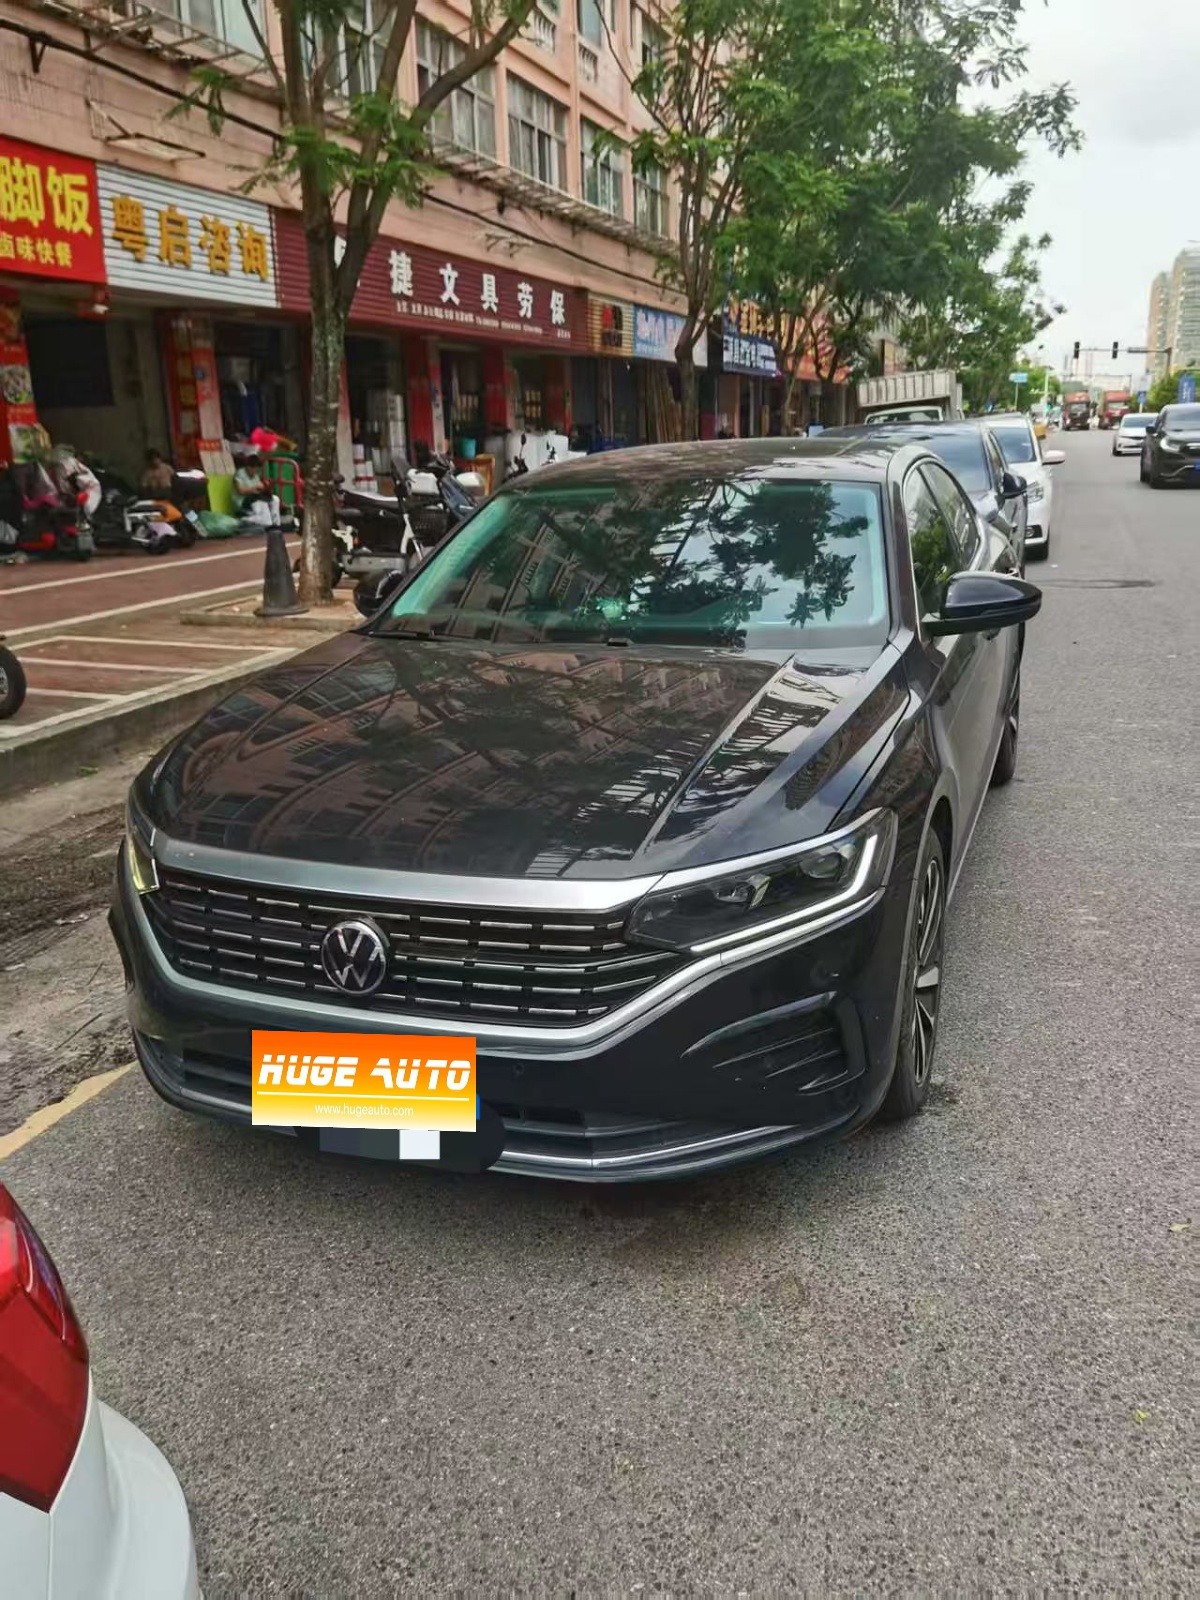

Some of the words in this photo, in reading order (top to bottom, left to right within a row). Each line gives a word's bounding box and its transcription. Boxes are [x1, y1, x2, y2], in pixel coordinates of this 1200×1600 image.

[0, 155, 93, 236] 脚饭
[110, 193, 269, 282] 粤启咨询
[334, 234, 566, 325] 捷文具劳保
